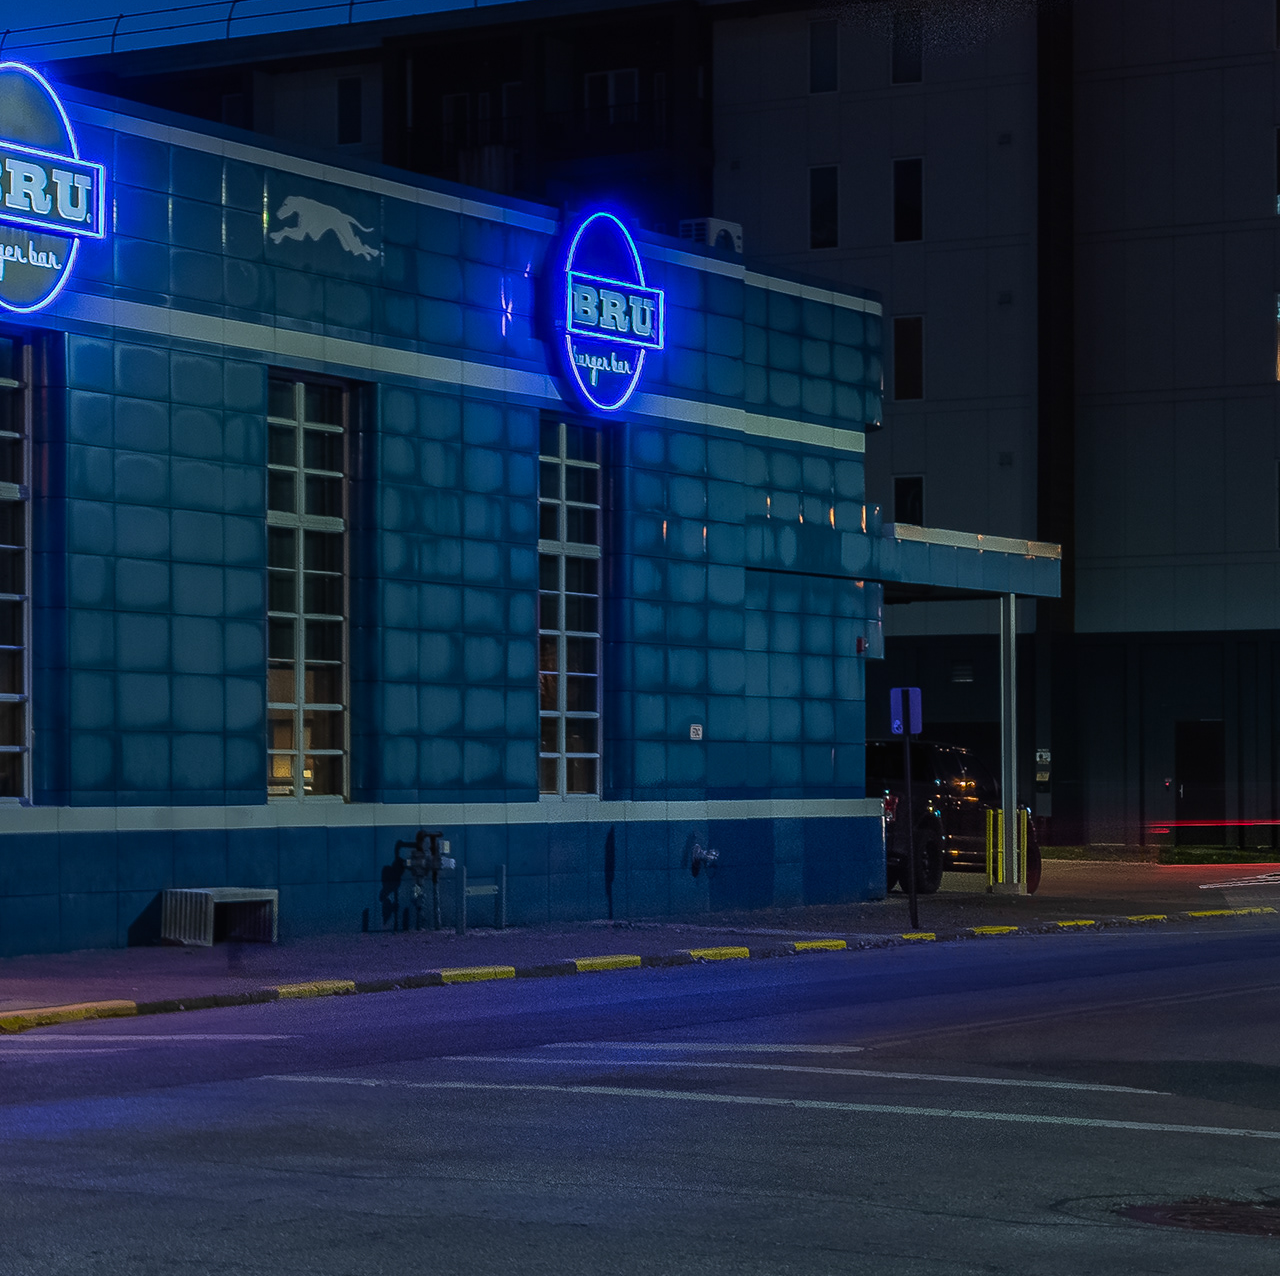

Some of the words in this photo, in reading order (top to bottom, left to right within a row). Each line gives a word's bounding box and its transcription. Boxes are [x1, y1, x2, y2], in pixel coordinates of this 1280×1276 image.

[28, 240, 63, 270] bar
[571, 282, 656, 336] BRU
[571, 344, 611, 387] burger
[610, 351, 634, 375] bar
